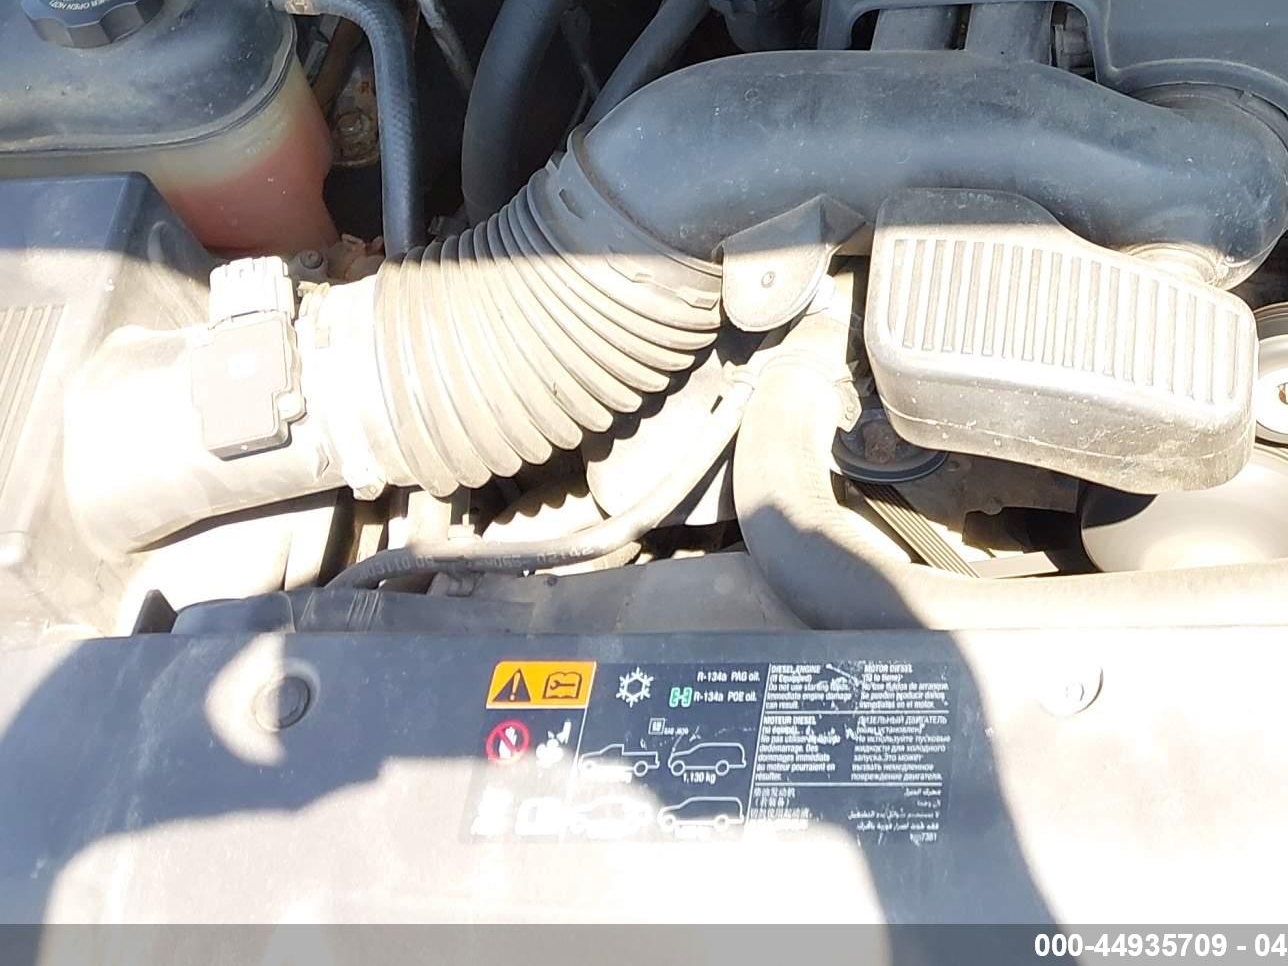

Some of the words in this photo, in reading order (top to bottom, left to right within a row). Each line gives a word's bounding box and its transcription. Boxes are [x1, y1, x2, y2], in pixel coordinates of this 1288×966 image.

[66, 1, 91, 12] OPEN
[696, 671, 727, 683] R-134a
[730, 671, 748, 682] PAG
[693, 690, 724, 703] R-134a
[727, 690, 745, 702] POE
[705, 772, 717, 785] kg
